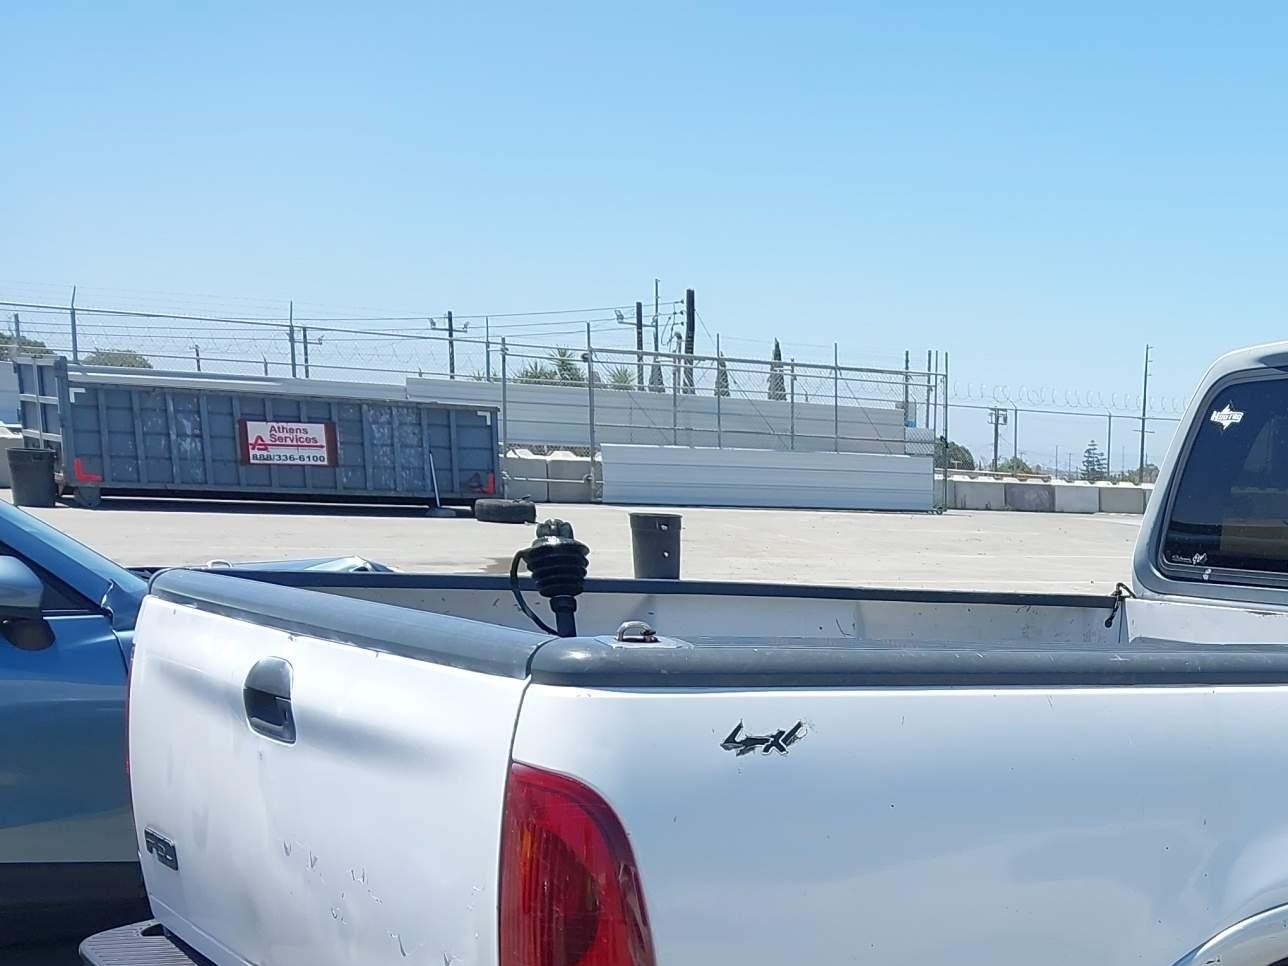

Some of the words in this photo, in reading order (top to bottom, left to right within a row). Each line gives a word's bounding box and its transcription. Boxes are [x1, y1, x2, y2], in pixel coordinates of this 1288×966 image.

[269, 425, 309, 434] Athens
[269, 433, 318, 444] Services
[251, 453, 326, 463] 888/336-6100
